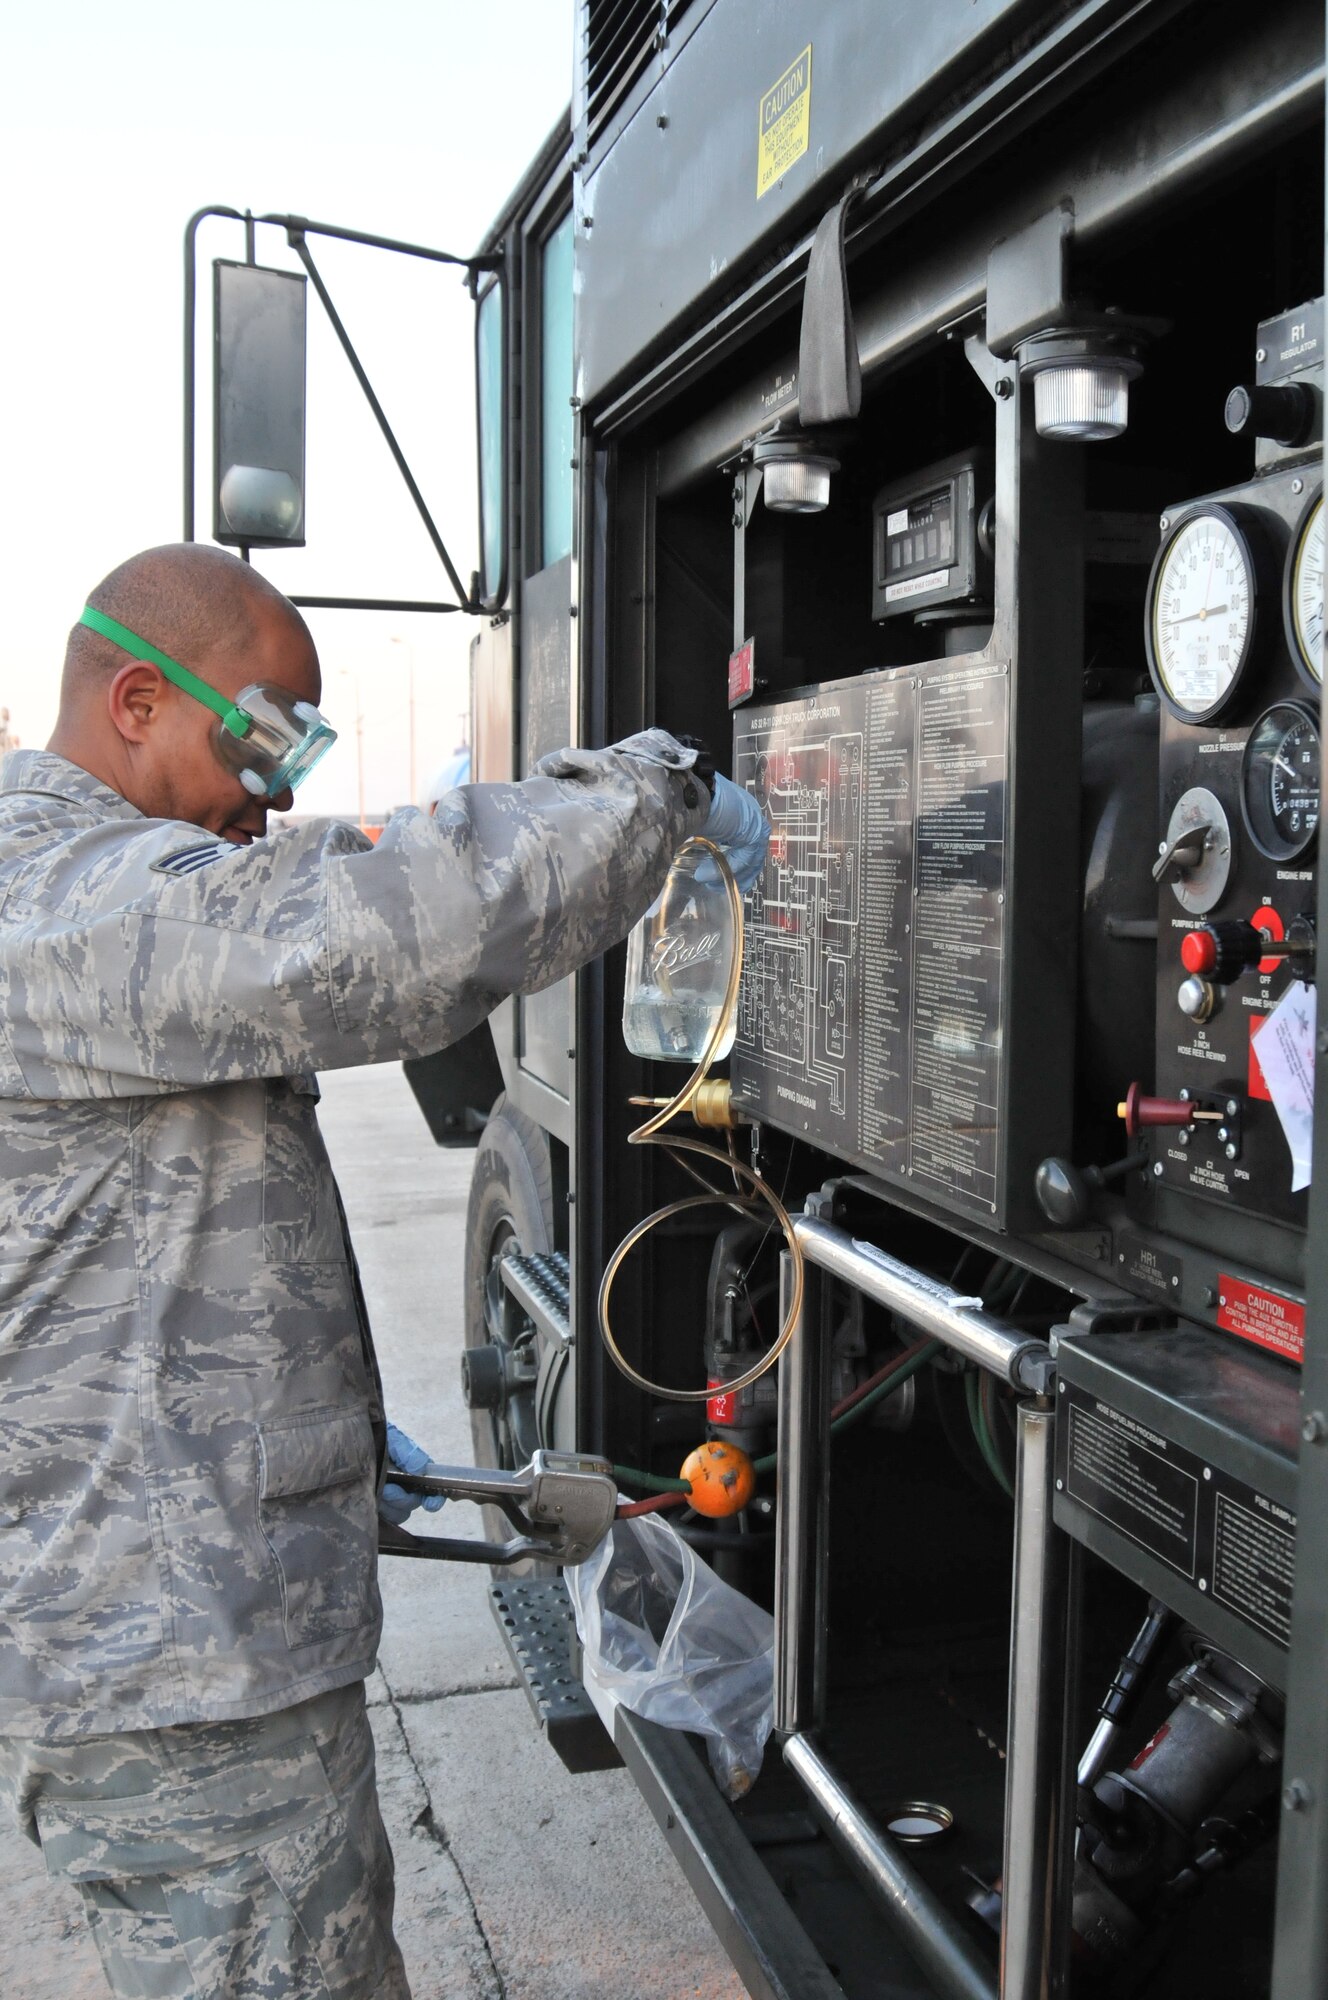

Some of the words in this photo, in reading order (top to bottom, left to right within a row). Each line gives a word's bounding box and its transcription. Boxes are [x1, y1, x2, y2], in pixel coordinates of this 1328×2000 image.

[765, 65, 803, 124] CAUTION
[764, 132, 772, 146] DO
[773, 120, 782, 137] NOT
[782, 96, 804, 127] OPERATE
[765, 140, 774, 158] THIS
[776, 109, 802, 147] EQUIPMENT
[773, 132, 794, 161] WITHOUT
[762, 167, 772, 185] EAR
[775, 136, 803, 170] PROTECTION
[1291, 322, 1304, 342] R1
[1280, 338, 1316, 360] REGULATOR
[764, 390, 778, 408] FLOW
[778, 380, 792, 400] METER
[910, 513, 933, 529] ALLONS
[1203, 546, 1210, 562] 50
[1216, 553, 1224, 568] 60
[1189, 555, 1197, 571] 40
[1179, 574, 1186, 590] 30
[1226, 570, 1234, 585] 70
[1173, 598, 1180, 614] 20
[1231, 594, 1239, 610] 80
[1229, 623, 1237, 638] 90
[1218, 645, 1229, 660] 100
[763, 717, 771, 727] R-11
[772, 713, 791, 727] OSHKOSH
[792, 711, 806, 722] TRUCK
[807, 706, 840, 720] CORPORATION
[1219, 734, 1226, 742] G1
[1199, 744, 1219, 753] NOZZLE
[1220, 742, 1246, 752] PRESSUR
[951, 761, 966, 769] PUMPING
[966, 760, 987, 768] PROCEDURE
[940, 842, 950, 850] FLOW
[950, 842, 964, 850] PUMPING
[965, 843, 986, 851] PROCEDURE
[1277, 870, 1298, 880] ENGINE
[1299, 871, 1312, 880] RPM
[1262, 897, 1271, 905] ON
[1172, 919, 1193, 928] PUMPING
[654, 932, 721, 974] Ball
[932, 942, 944, 950] DEFUEL
[945, 943, 959, 952] PUMPING
[960, 946, 981, 955] PROCEDURE
[1260, 975, 1271, 984] OFF
[1242, 996, 1262, 1007] ENGINE
[1198, 1040, 1210, 1049] INCH
[1178, 1045, 1191, 1055] HOSE
[1192, 1048, 1205, 1058] REEL
[1206, 1050, 1226, 1062] REWIND
[777, 1085, 795, 1102] PUMPING
[796, 1092, 816, 1110] DIAGRAM
[955, 1098, 975, 1112] PROCEDURE
[1168, 1149, 1187, 1161] CLOSED
[932, 1154, 951, 1168] EMERGENCY
[952, 1161, 972, 1176] PROCEDURE
[1198, 1167, 1210, 1178] INCH
[1211, 1171, 1225, 1182] HOSE
[1234, 1169, 1250, 1180] OPEN
[1190, 1173, 1205, 1186] VALVE
[1206, 1179, 1230, 1193] CONTROL
[1140, 1249, 1156, 1268] HR1
[1152, 1268, 1163, 1279] REEL
[1147, 1275, 1167, 1289] RELEASE
[1248, 1294, 1284, 1319] CAUTION
[1234, 1301, 1248, 1313] PUSH
[1249, 1306, 1258, 1317] THE
[1259, 1310, 1270, 1321] AUX
[1271, 1315, 1298, 1335] THROTTLE
[1225, 1306, 1248, 1323] CONTROL
[1250, 1316, 1255, 1326] IN
[1256, 1318, 1276, 1335] BEFORE
[1277, 1329, 1289, 1340] AND
[1290, 1333, 1304, 1347] AFTE
[1232, 1318, 1241, 1329] ALL
[1242, 1324, 1264, 1339] PUMPING
[1265, 1332, 1300, 1354] OPERATIONS
[1096, 1402, 1109, 1416] HOSE
[1110, 1409, 1136, 1431] DEFUELING
[1136, 1425, 1166, 1449] PROCEDURE
[1255, 1495, 1270, 1512] FUEL
[1271, 1504, 1297, 1526] SAMPLE
